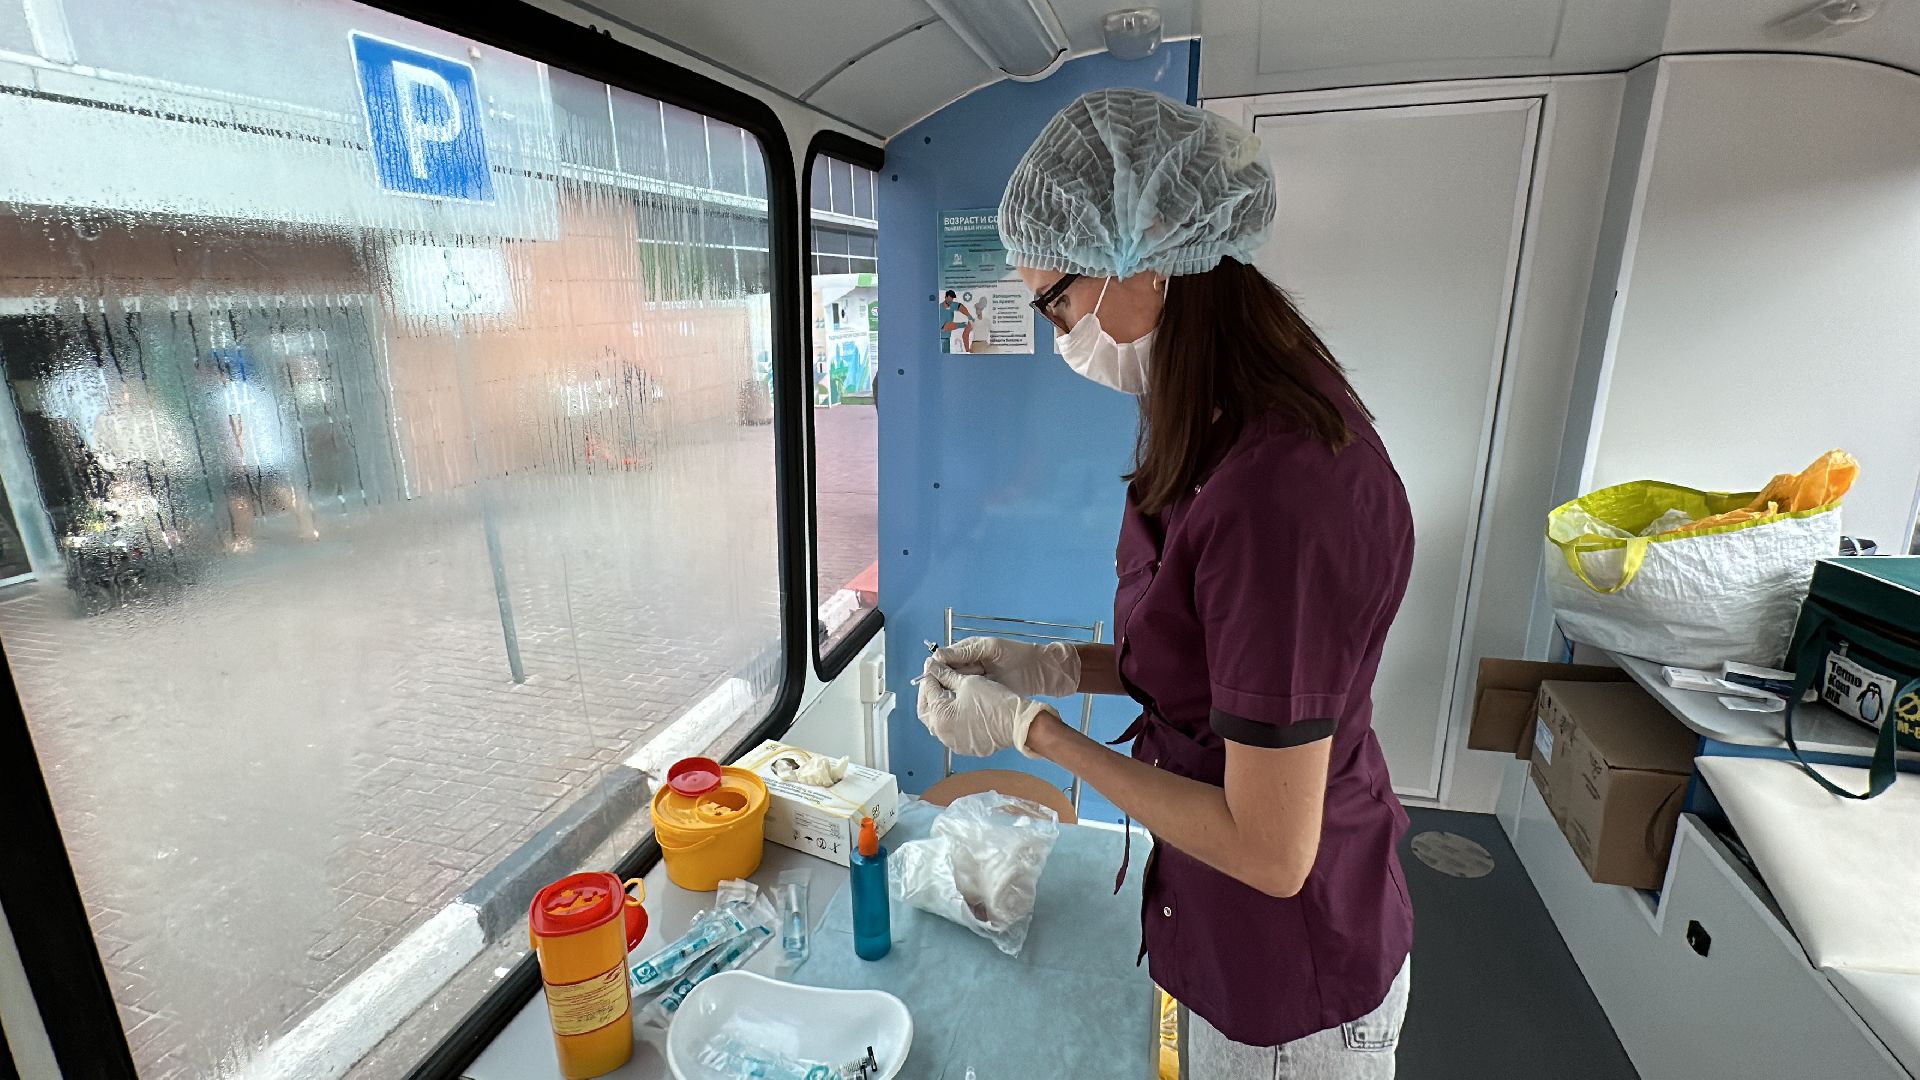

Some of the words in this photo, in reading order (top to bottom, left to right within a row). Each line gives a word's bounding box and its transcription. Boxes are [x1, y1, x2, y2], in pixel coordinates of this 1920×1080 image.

[391, 60, 461, 179] P
[944, 216, 979, 225] ВОЗРАСТ
[980, 216, 987, 224] И
